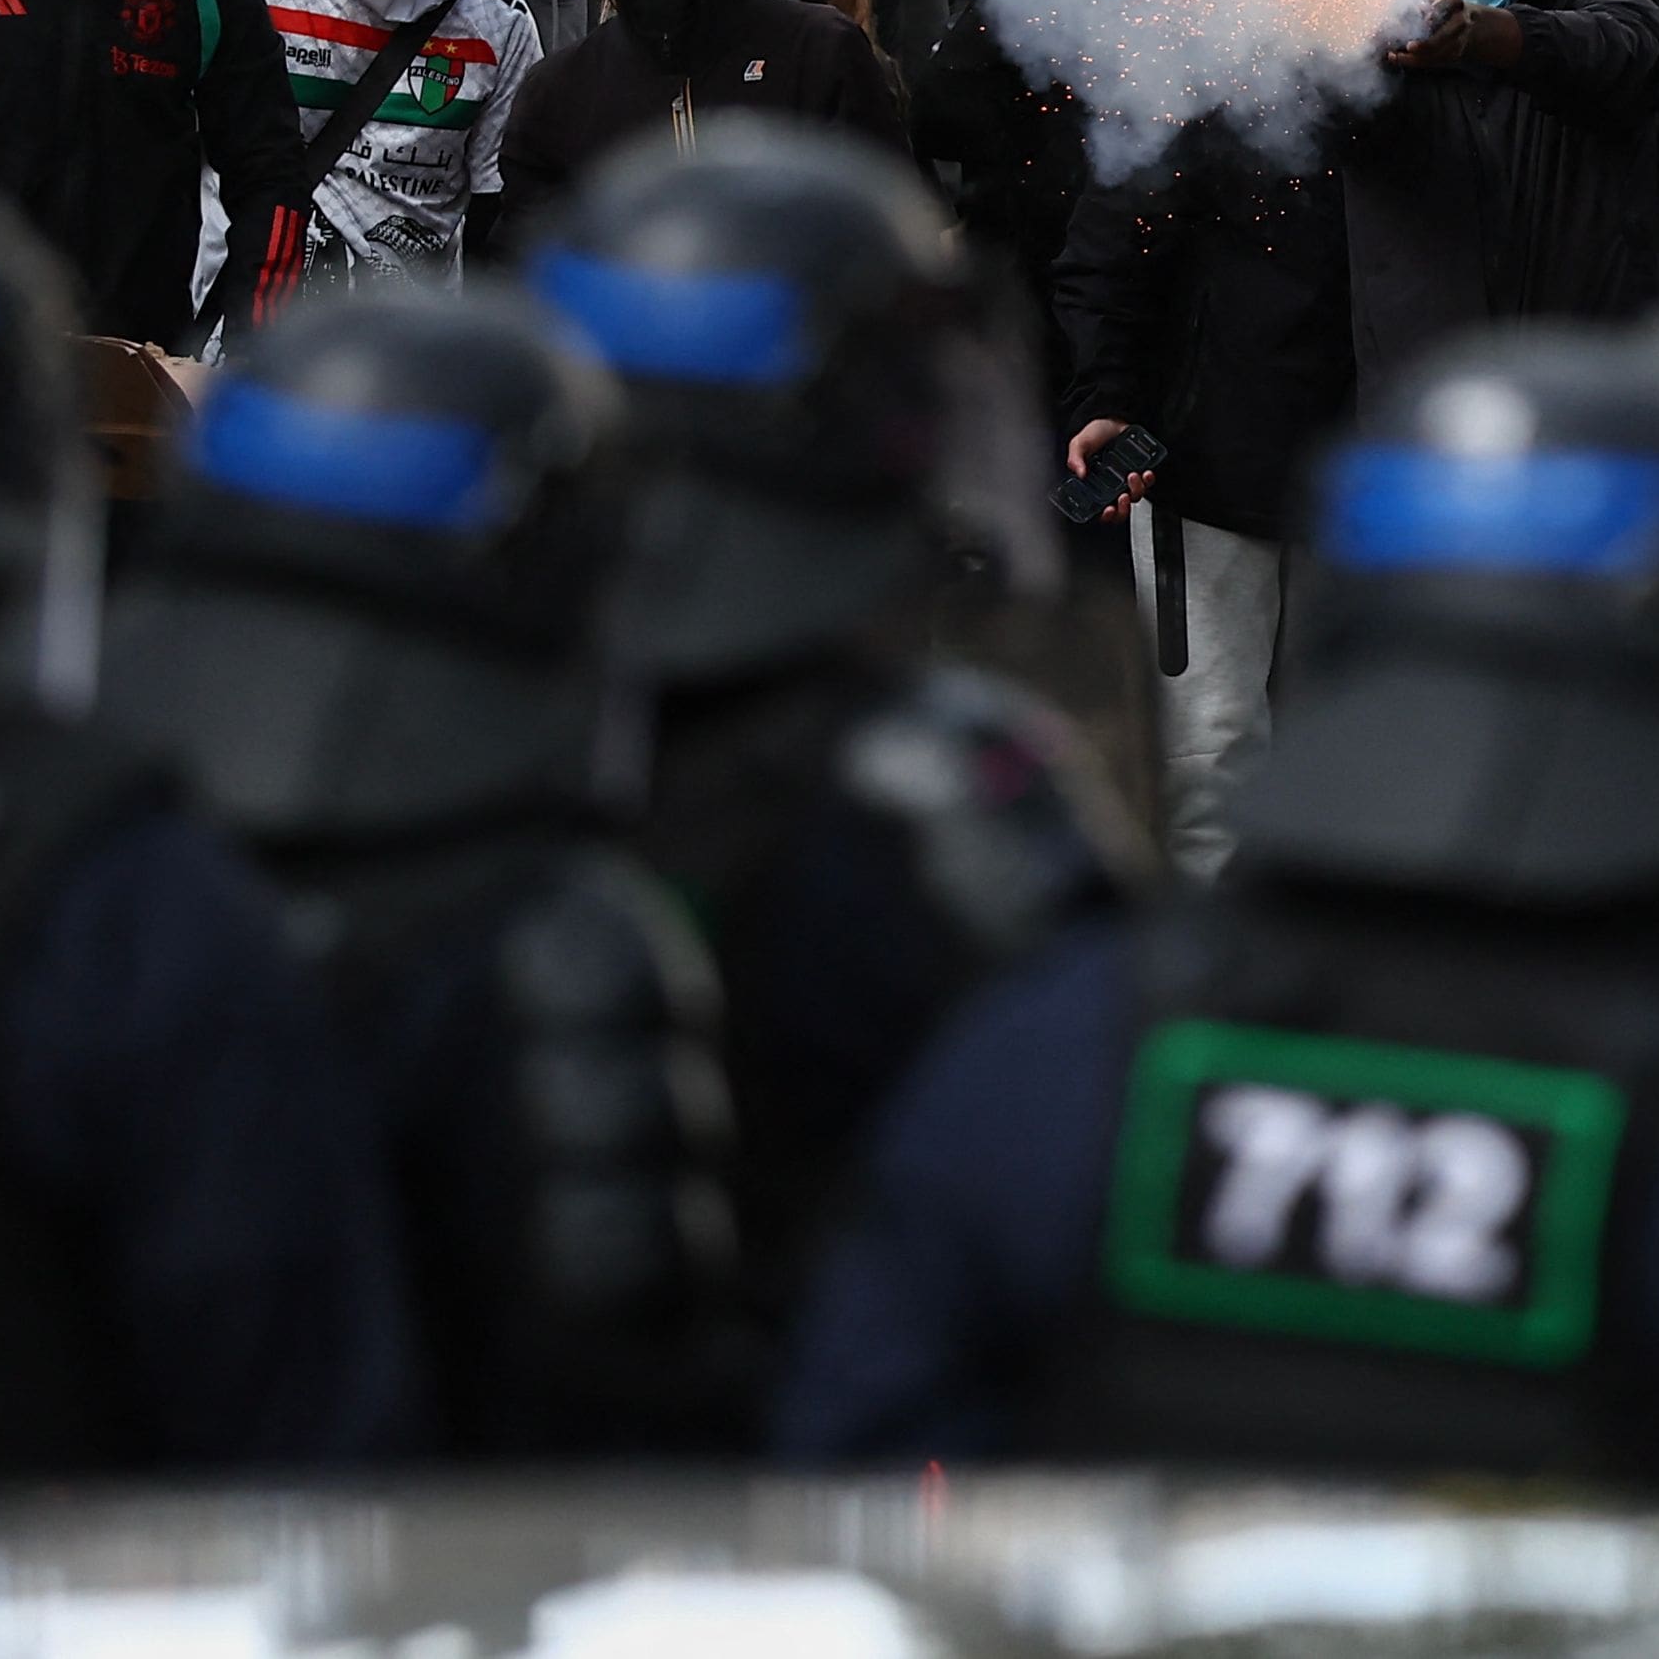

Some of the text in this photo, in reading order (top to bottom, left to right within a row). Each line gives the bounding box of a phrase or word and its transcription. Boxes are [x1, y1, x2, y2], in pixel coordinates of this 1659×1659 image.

[286, 46, 332, 68] apelli
[410, 68, 460, 86] PALESTINO
[1199, 1079, 1531, 1305] 712
